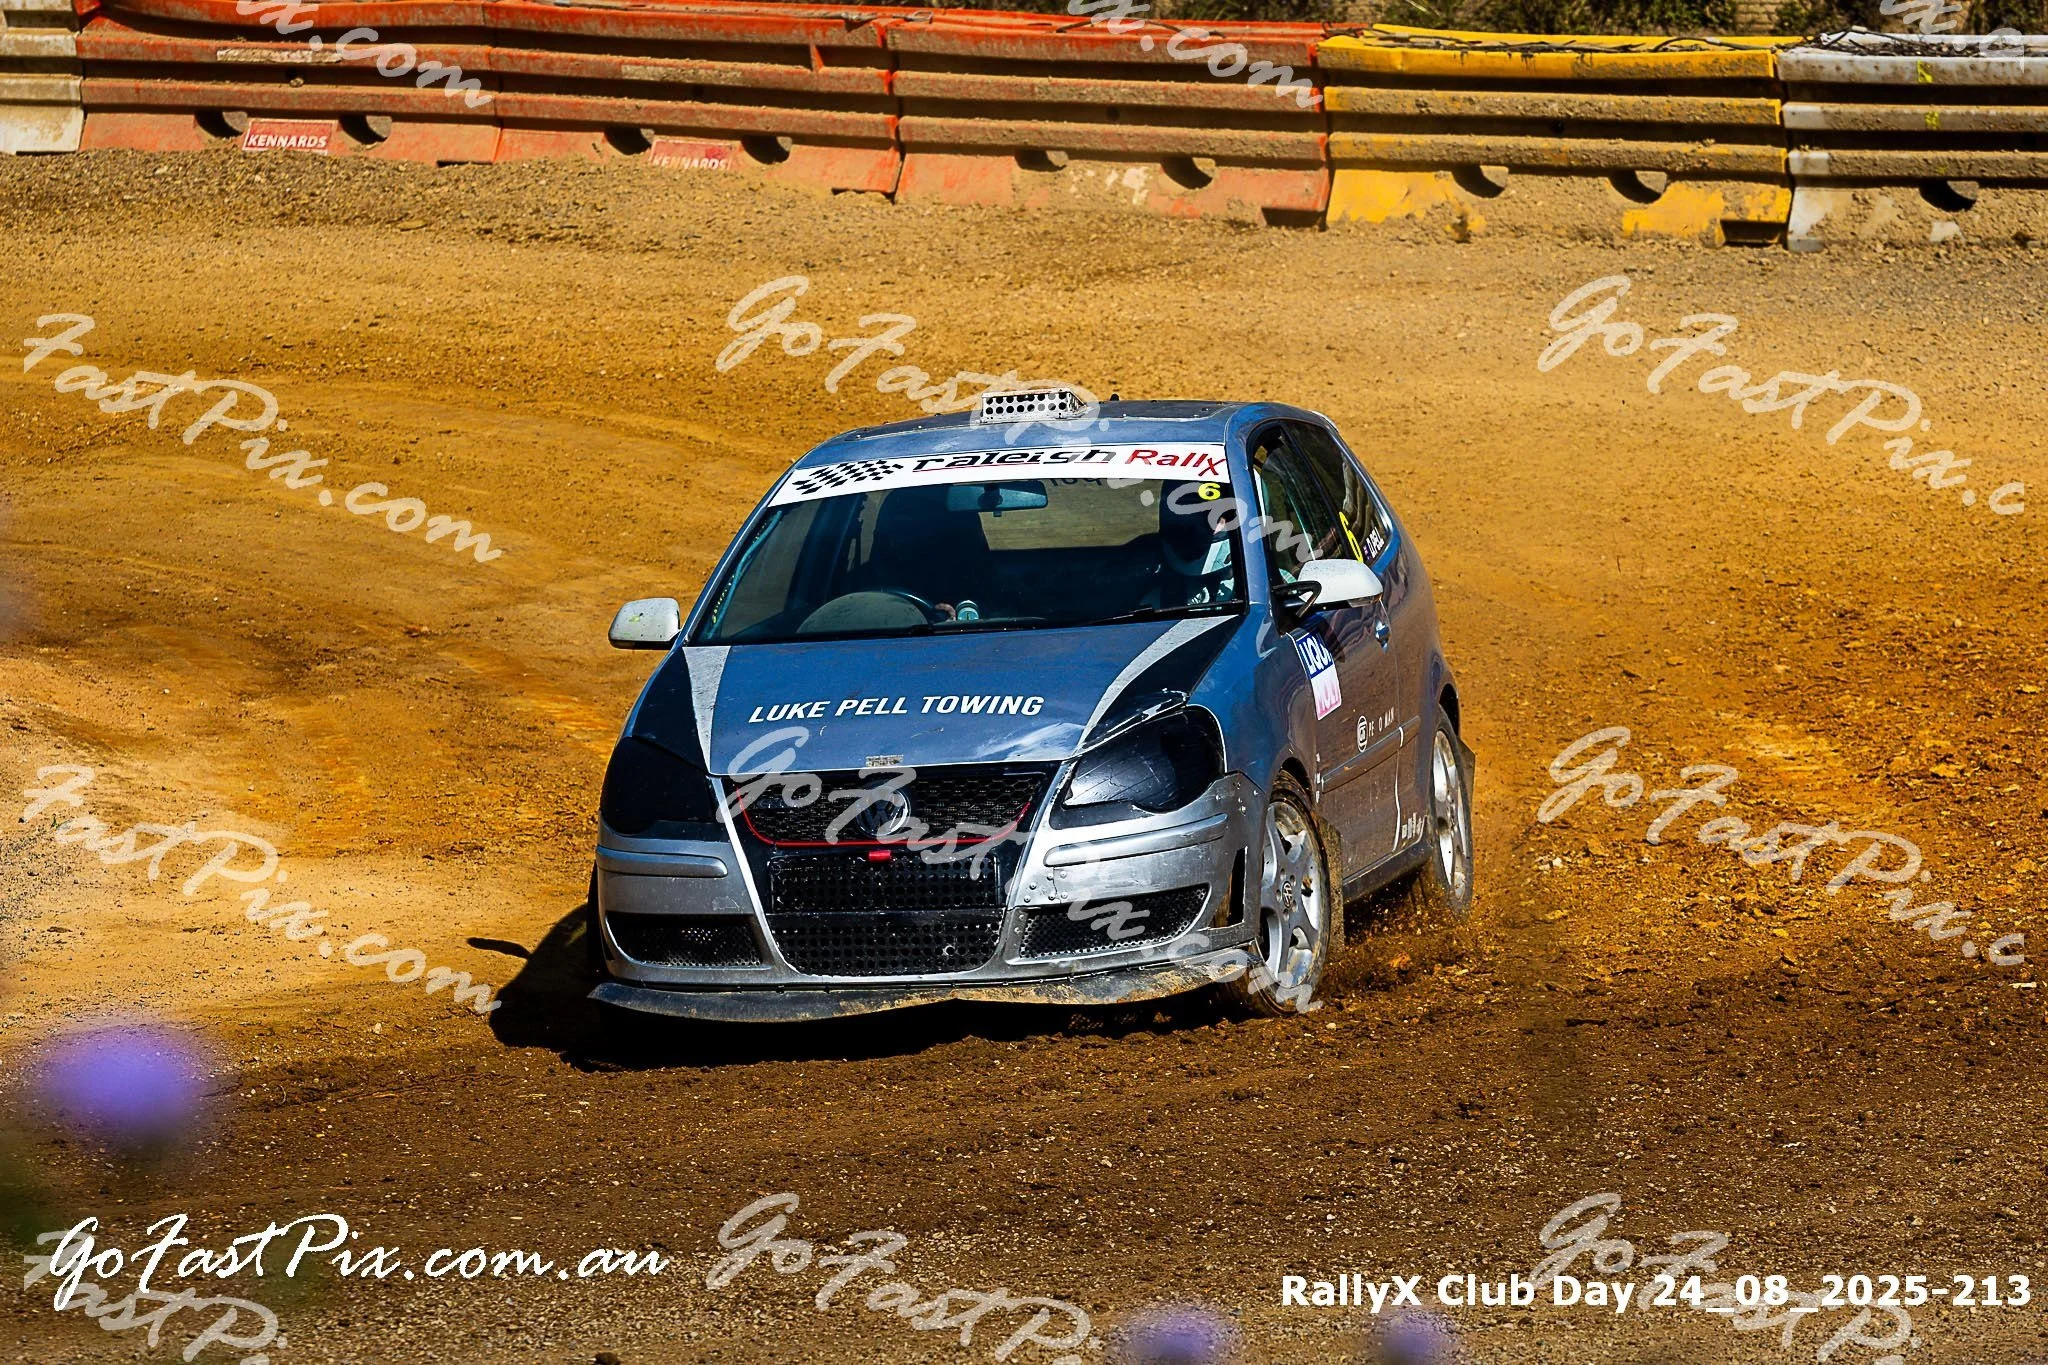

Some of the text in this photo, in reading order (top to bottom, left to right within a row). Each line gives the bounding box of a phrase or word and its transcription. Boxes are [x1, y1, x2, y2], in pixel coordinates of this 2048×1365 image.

[248, 134, 327, 148] KENNARDS
[912, 448, 1117, 472] raleigh
[1198, 483, 1221, 501] 6
[1339, 512, 1363, 563] 6
[748, 695, 1045, 723] LUKE PELL TOWING
